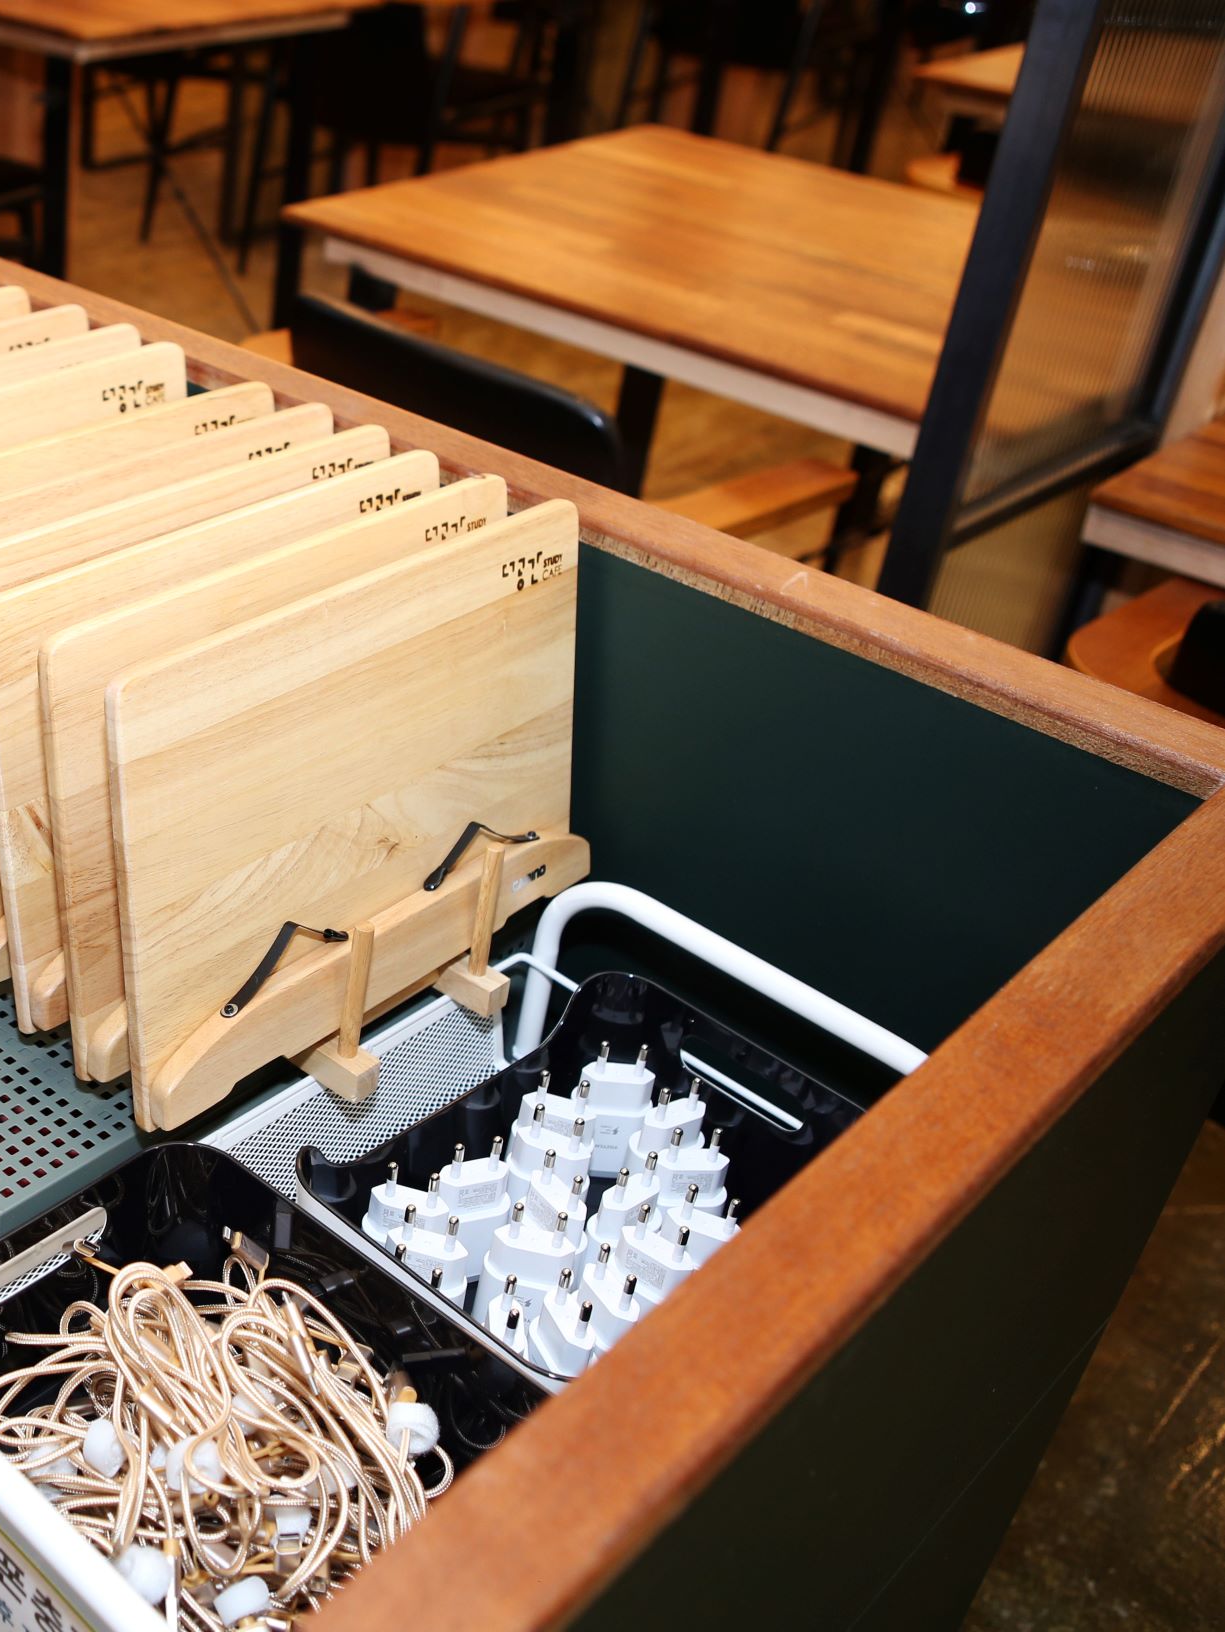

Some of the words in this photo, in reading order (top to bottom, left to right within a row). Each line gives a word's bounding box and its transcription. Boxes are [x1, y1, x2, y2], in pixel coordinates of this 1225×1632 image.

[467, 517, 486, 532] STUDY
[543, 554, 562, 568] STUDY
[542, 565, 562, 581] CAFE
